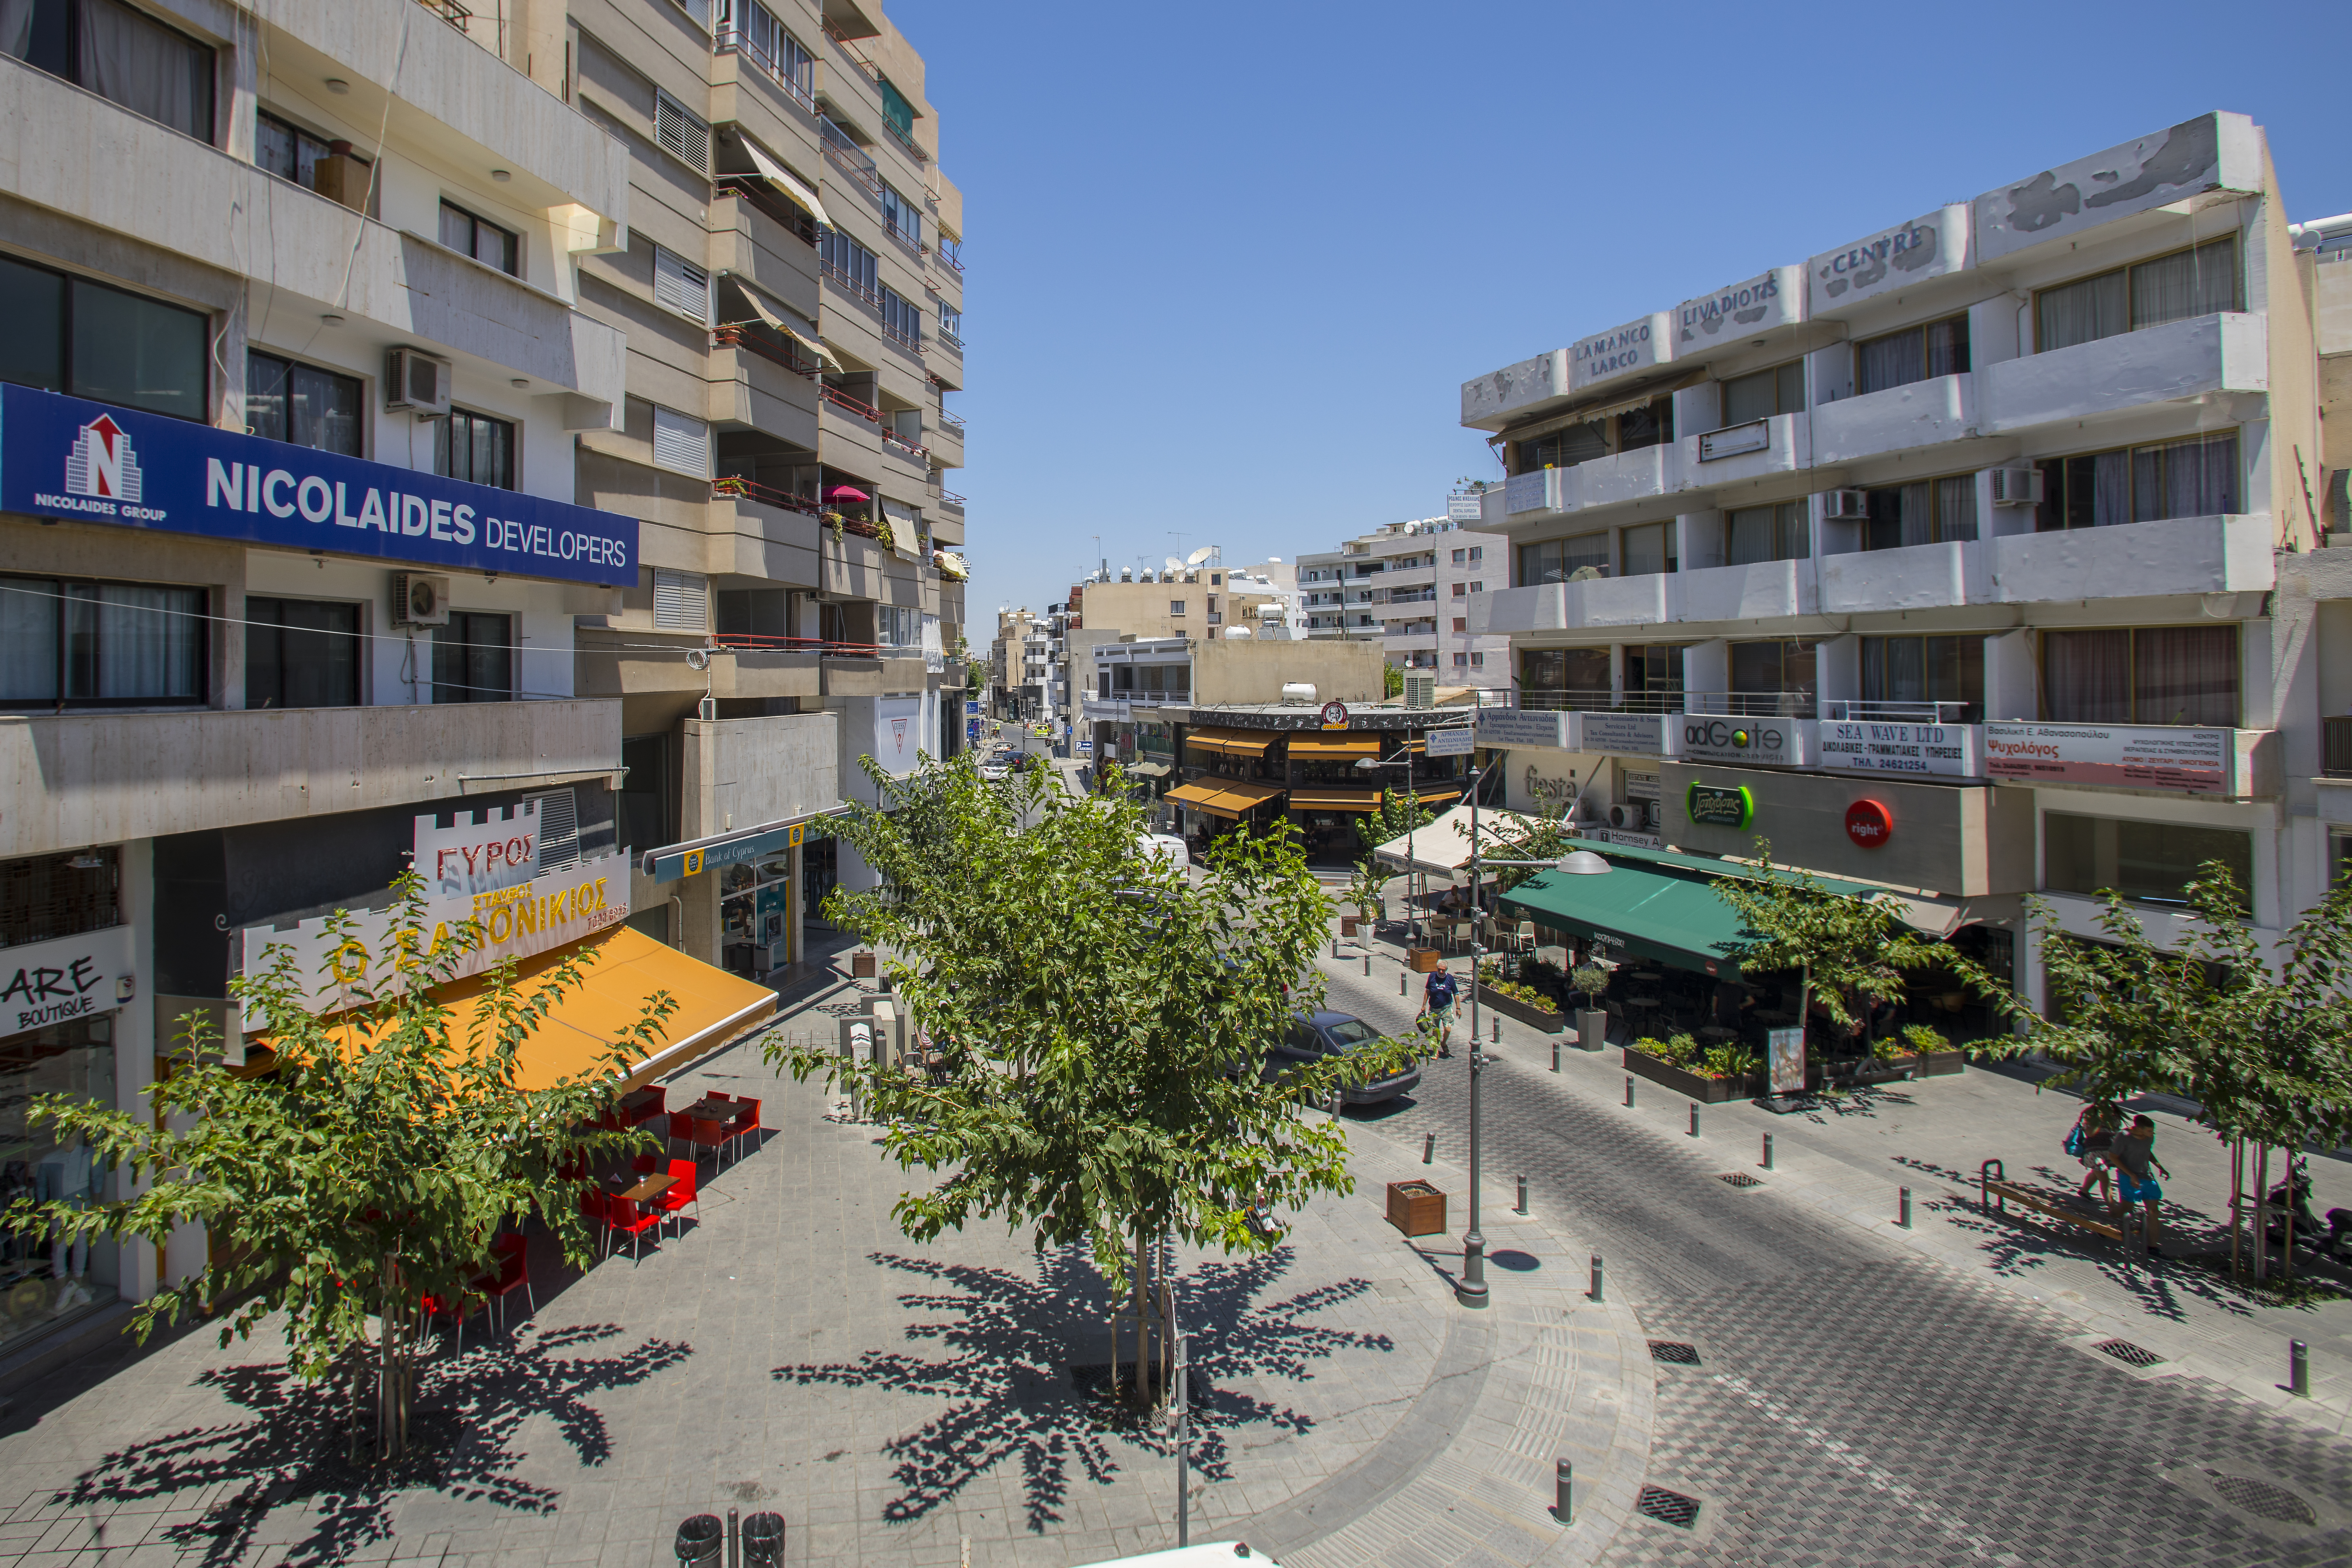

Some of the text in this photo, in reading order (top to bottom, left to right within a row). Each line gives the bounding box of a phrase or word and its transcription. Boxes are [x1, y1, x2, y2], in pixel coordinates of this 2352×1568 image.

[1575, 325, 1650, 361] LAMANCO
[1591, 350, 1638, 377] LARCO
[34, 493, 167, 521] NICOLAIDES GROUP
[207, 457, 626, 568] NICOLAIDES DEVELOPERS
[1487, 712, 1557, 722] Αρμάνδος Αντωνιάδης
[1685, 721, 1783, 750] adGate
[1837, 724, 1944, 743] SEA WAVE LTD
[1988, 726, 2025, 735] Βασιλική
[2037, 728, 2110, 739] Αθανασοπούλου
[1823, 741, 1863, 754] ΔΙΚΟΛΑΒΙΚΕΣ
[1868, 744, 1920, 757] ΓΡΑΜΜΑΤΙΑΚΕΣ
[1925, 746, 1962, 759] ΥΠΗΡΕΣΙΕΣ
[1988, 739, 2059, 758] Ψυχολόγος
[1853, 757, 1927, 771] ΤΗΛ. 24621254
[1524, 765, 1577, 799] fiesta
[1850, 812, 1882, 824] coffee
[1611, 831, 1649, 846] Hornsey
[1852, 823, 1878, 837] right
[437, 833, 534, 880] ΓΥΡΟΣ
[706, 851, 722, 865] Bank
[724, 848, 731, 860] of
[733, 846, 755, 860] Cyprus
[1377, 854, 1402, 865] SANDWICHES
[1405, 862, 1429, 872] BAKFAST
[1432, 868, 1450, 877] KEBABS
[473, 883, 533, 911] ΣΤΑΥΡΟΣ
[17, 996, 95, 1029] BOUTIQUE
